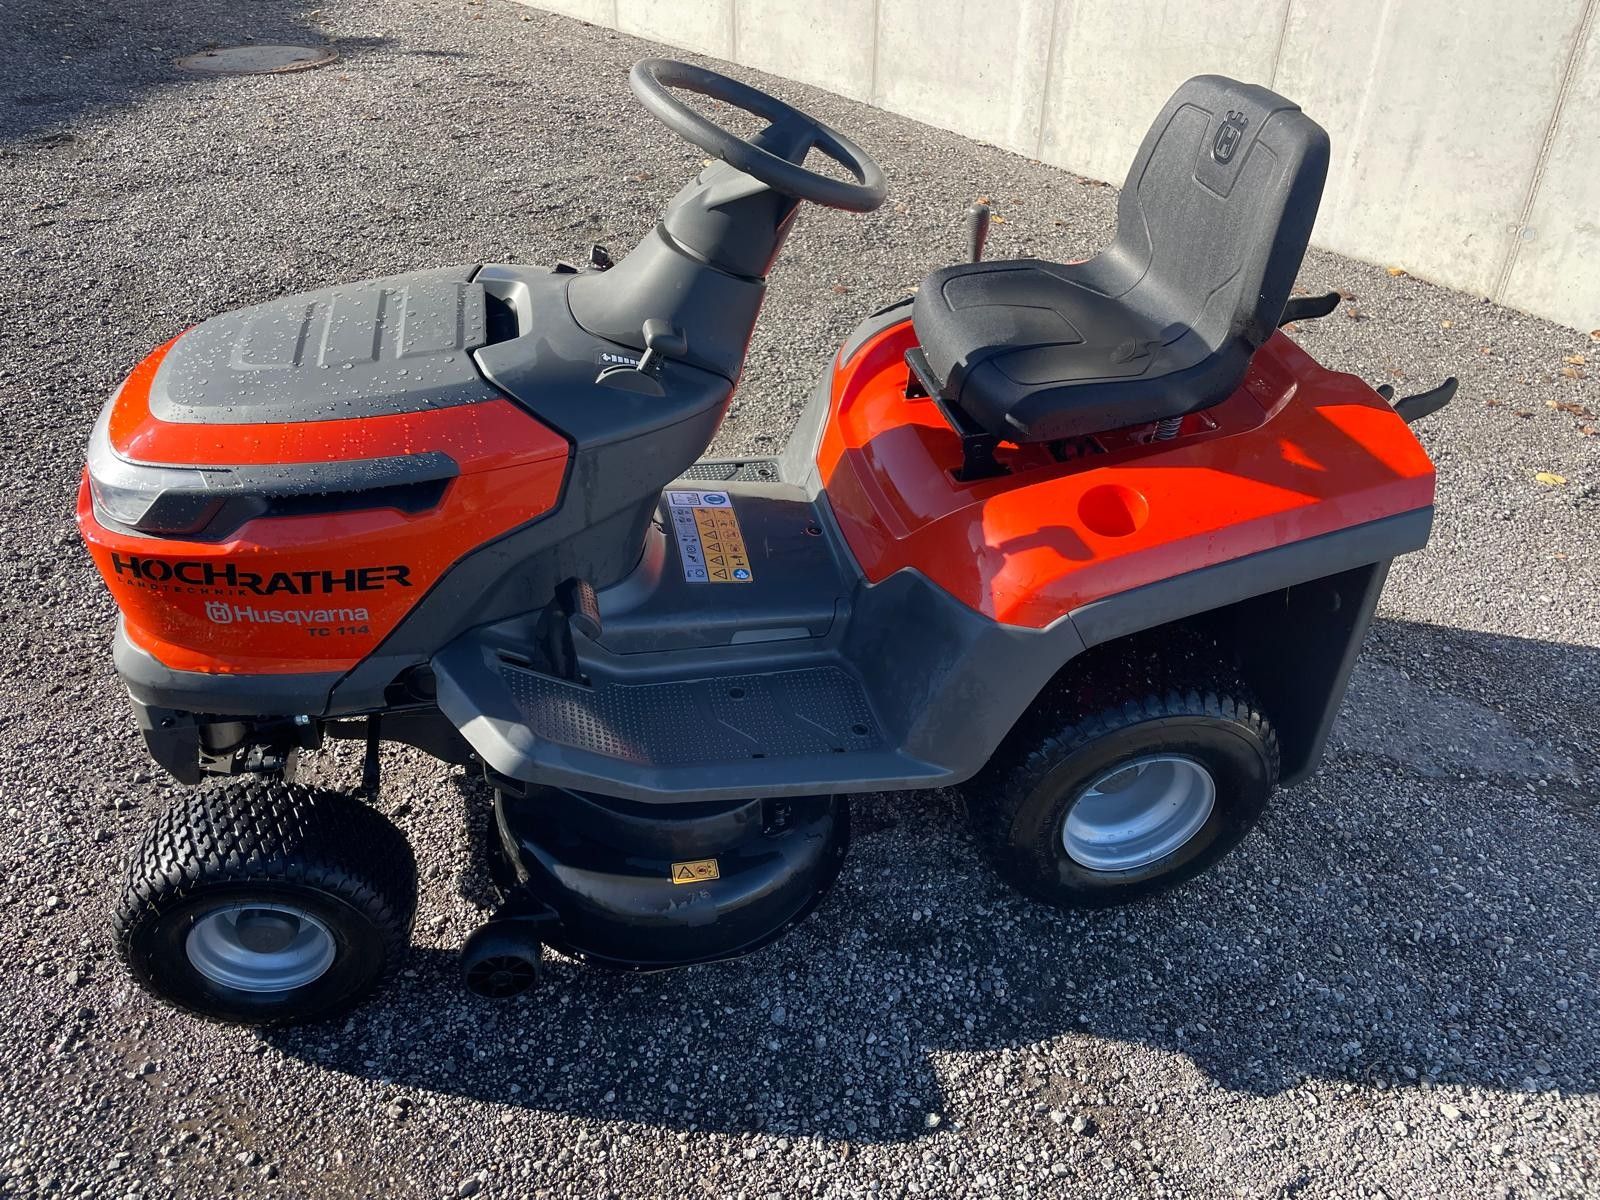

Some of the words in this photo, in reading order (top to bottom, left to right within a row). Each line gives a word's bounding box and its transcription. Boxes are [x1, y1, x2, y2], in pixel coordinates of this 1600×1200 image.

[111, 552, 413, 596] HOCHRATHER
[118, 576, 246, 596] LANDTECHNIK
[233, 605, 369, 625] Husqvarna
[307, 627, 330, 637] TC
[337, 625, 369, 635] 114
